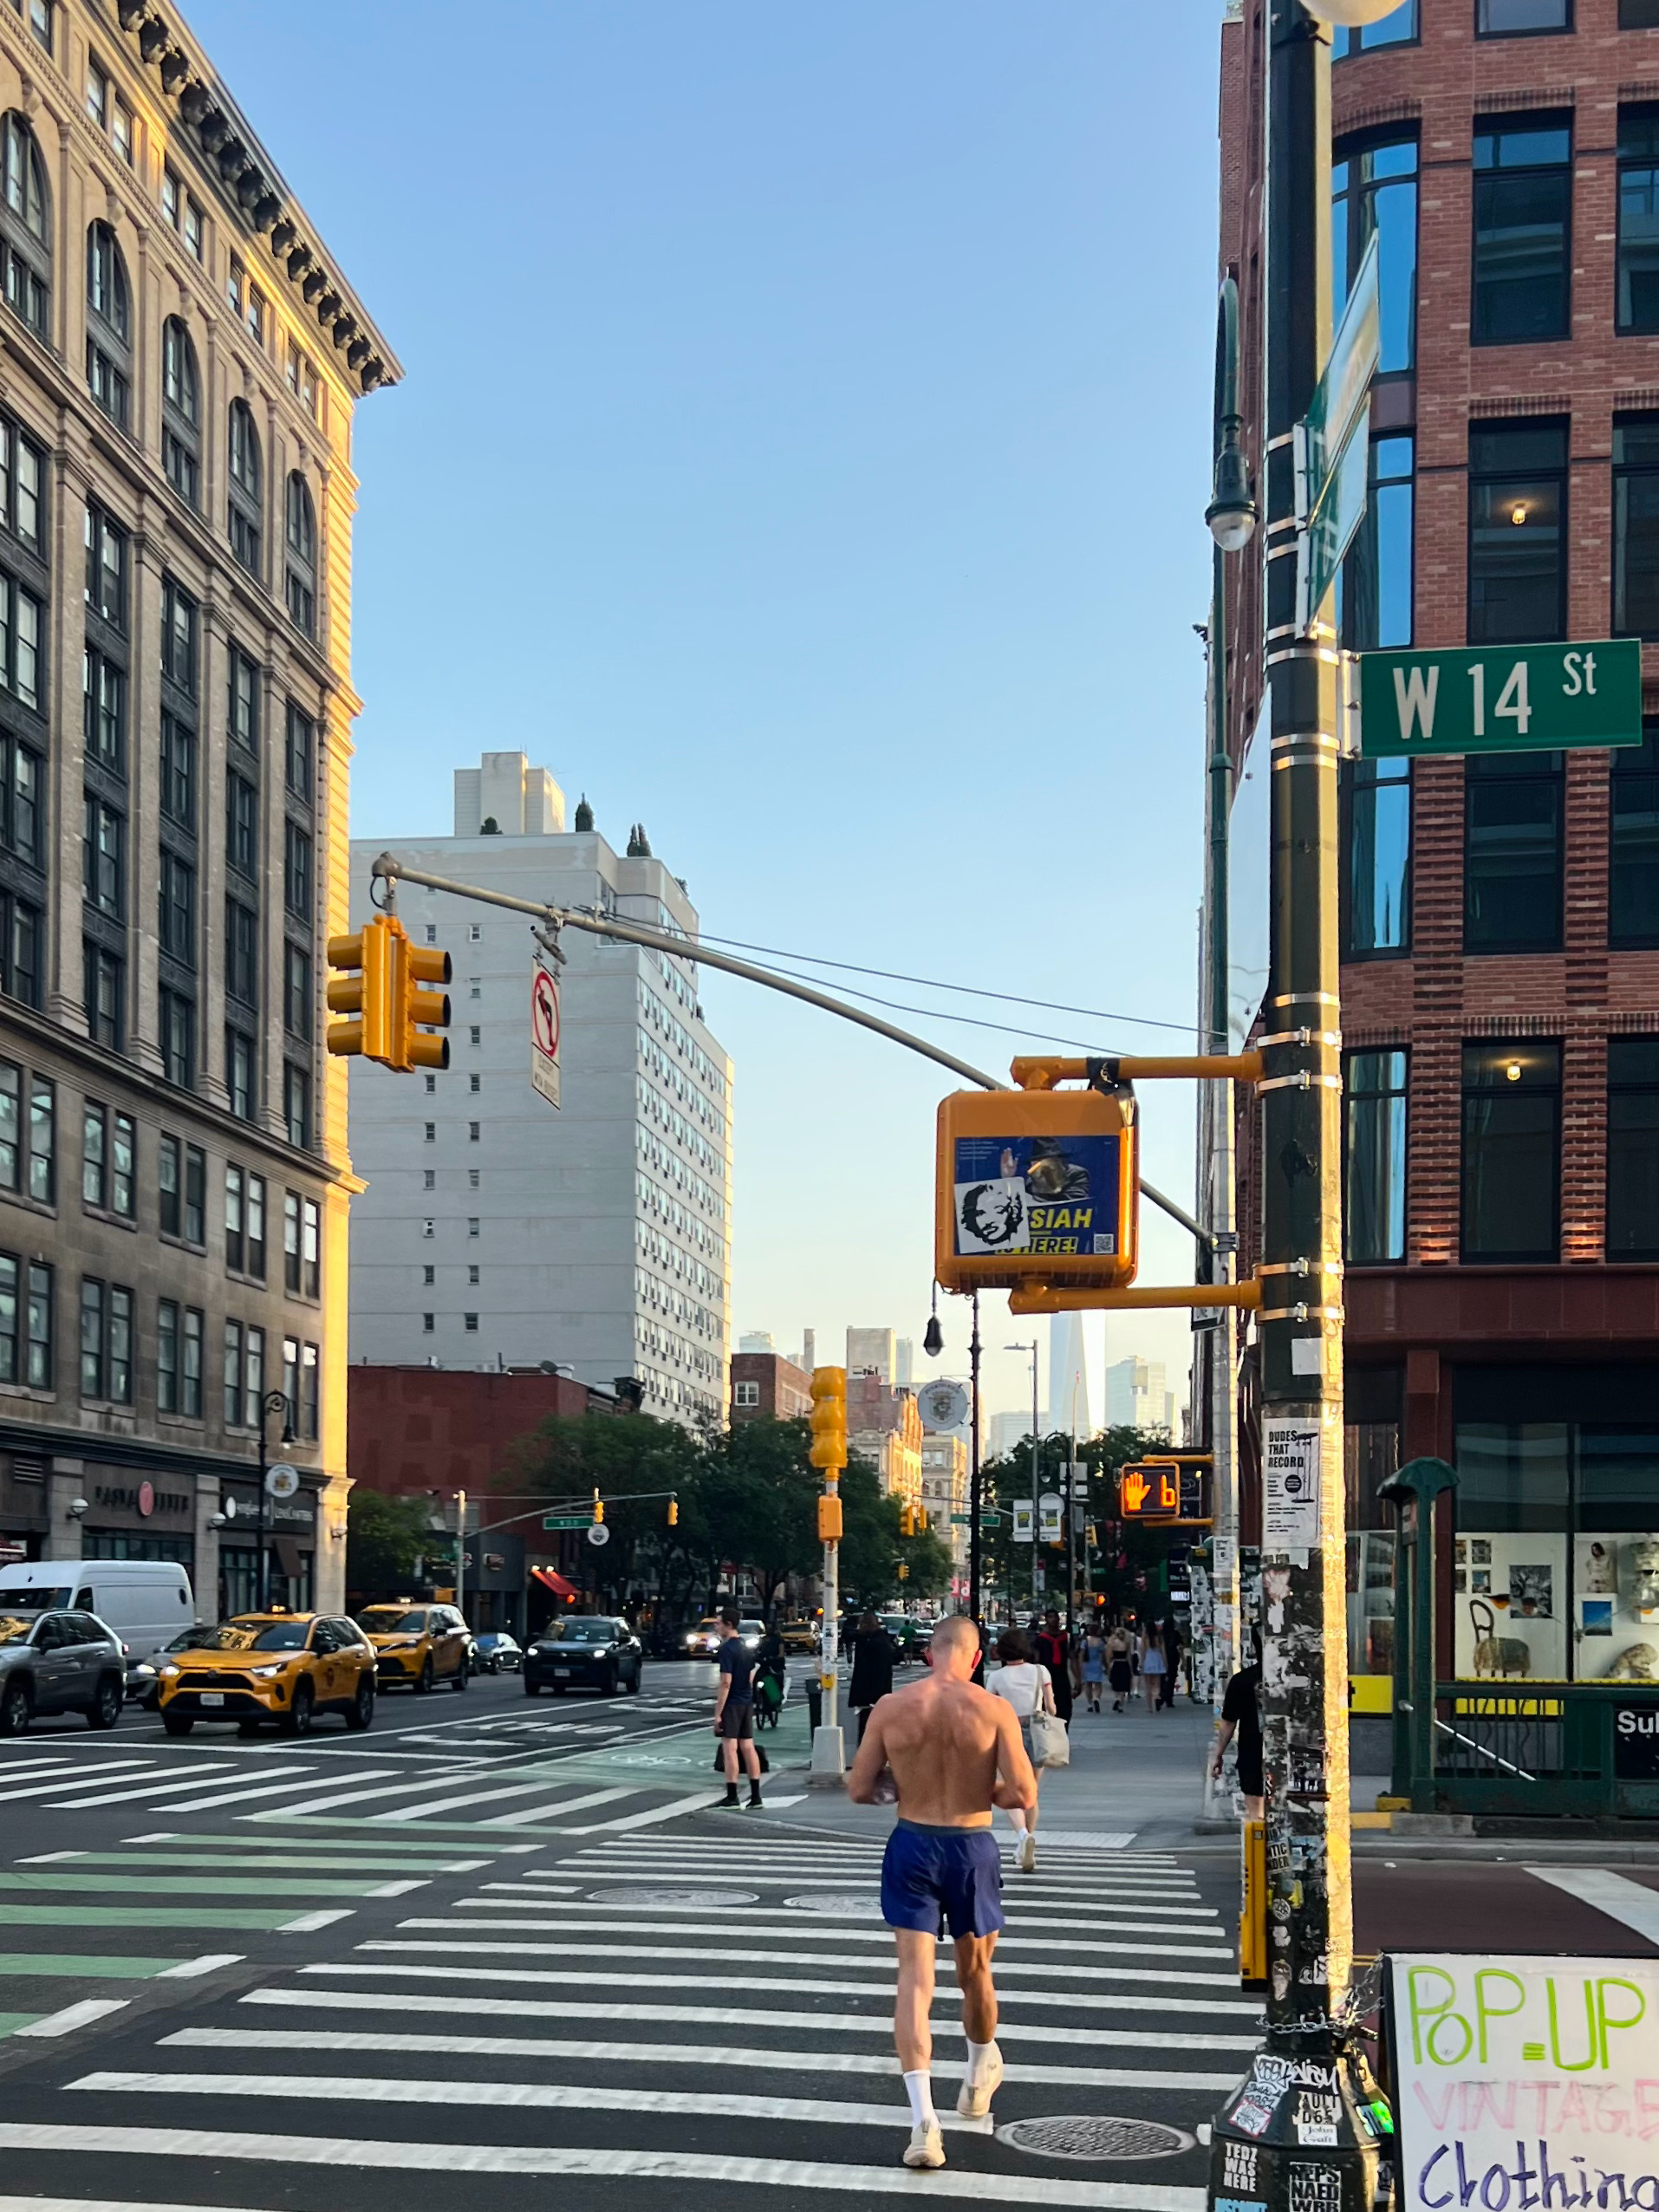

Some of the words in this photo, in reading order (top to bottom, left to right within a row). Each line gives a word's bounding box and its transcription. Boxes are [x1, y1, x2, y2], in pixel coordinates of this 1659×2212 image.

[1393, 666, 1440, 738] W
[1467, 661, 1532, 736] 14
[1562, 652, 1597, 696] St
[1027, 1207, 1093, 1229] SIAH
[1269, 1430, 1298, 1442] DUDES
[1268, 1444, 1289, 1455] THAT
[1268, 1456, 1304, 1468] RECORD
[1225, 2157, 1256, 2176] WAS
[1223, 2171, 1256, 2193] HERE
